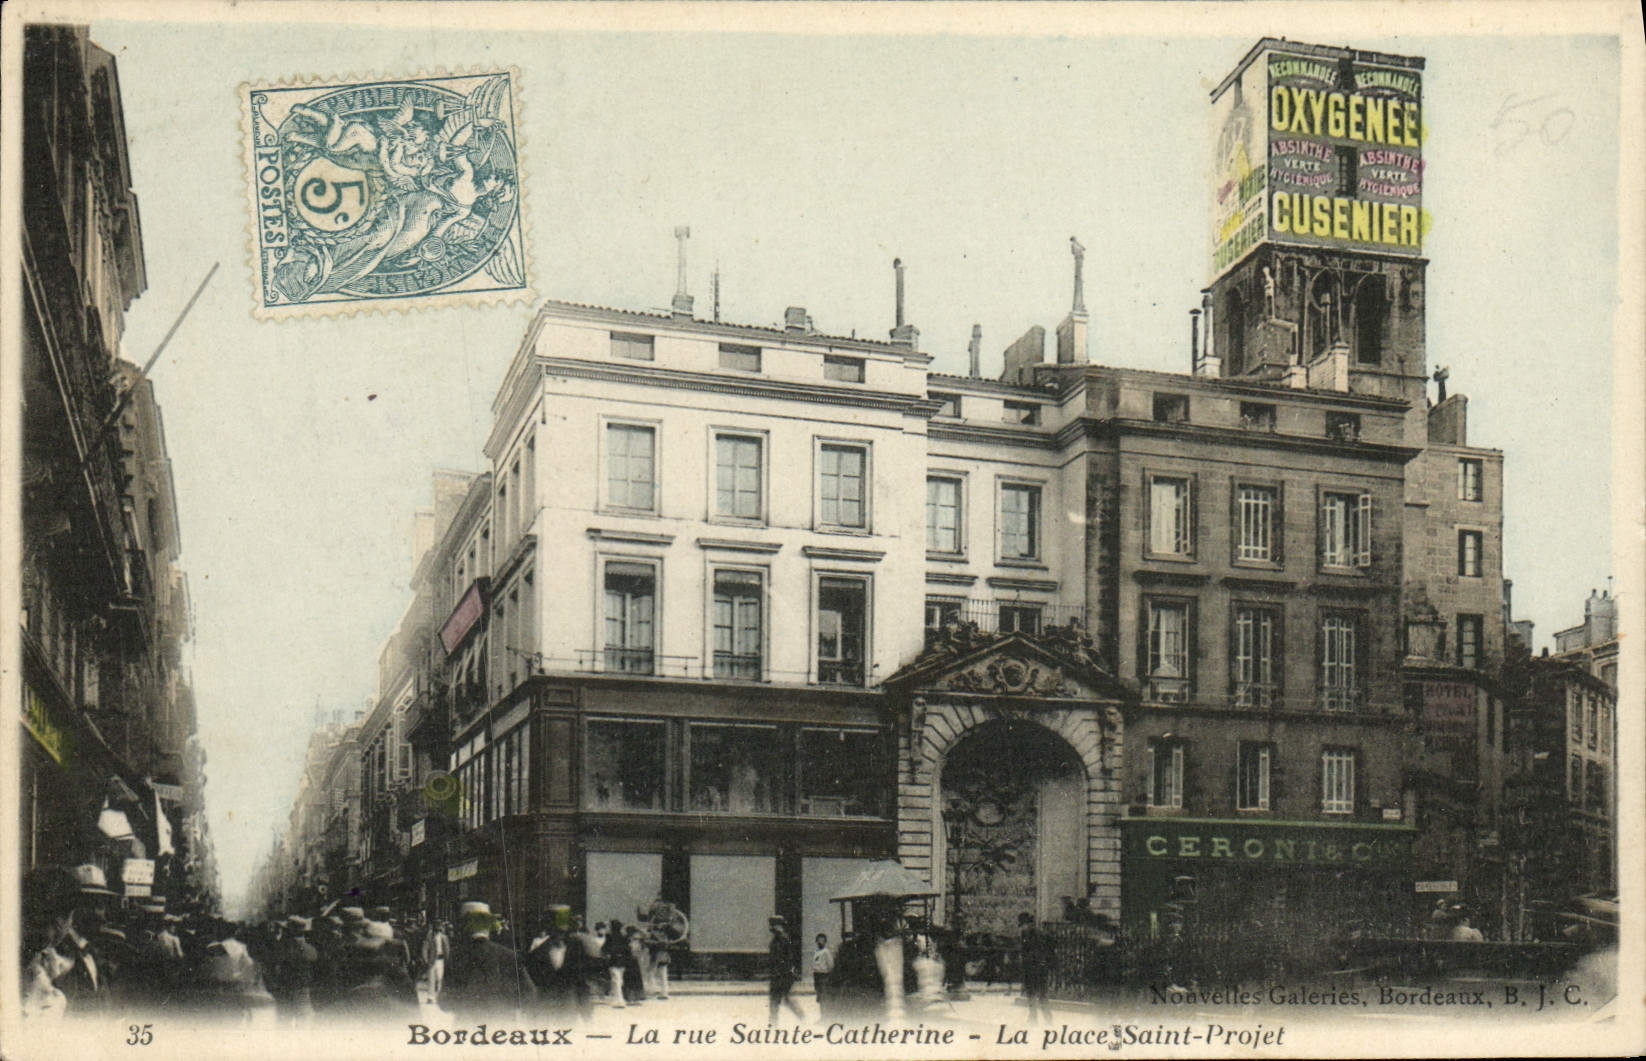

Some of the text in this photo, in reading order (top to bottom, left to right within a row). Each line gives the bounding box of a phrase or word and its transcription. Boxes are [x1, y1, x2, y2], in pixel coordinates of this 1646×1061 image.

[1271, 140, 1332, 163] ABSINTHE
[1360, 150, 1420, 174] ABSINTHE
[1284, 158, 1320, 175] VERTE
[1371, 168, 1407, 184] VERTE
[258, 149, 285, 245] POSTES
[1272, 190, 1419, 247] CUSENIER
[1146, 835, 1317, 861] CERONI
